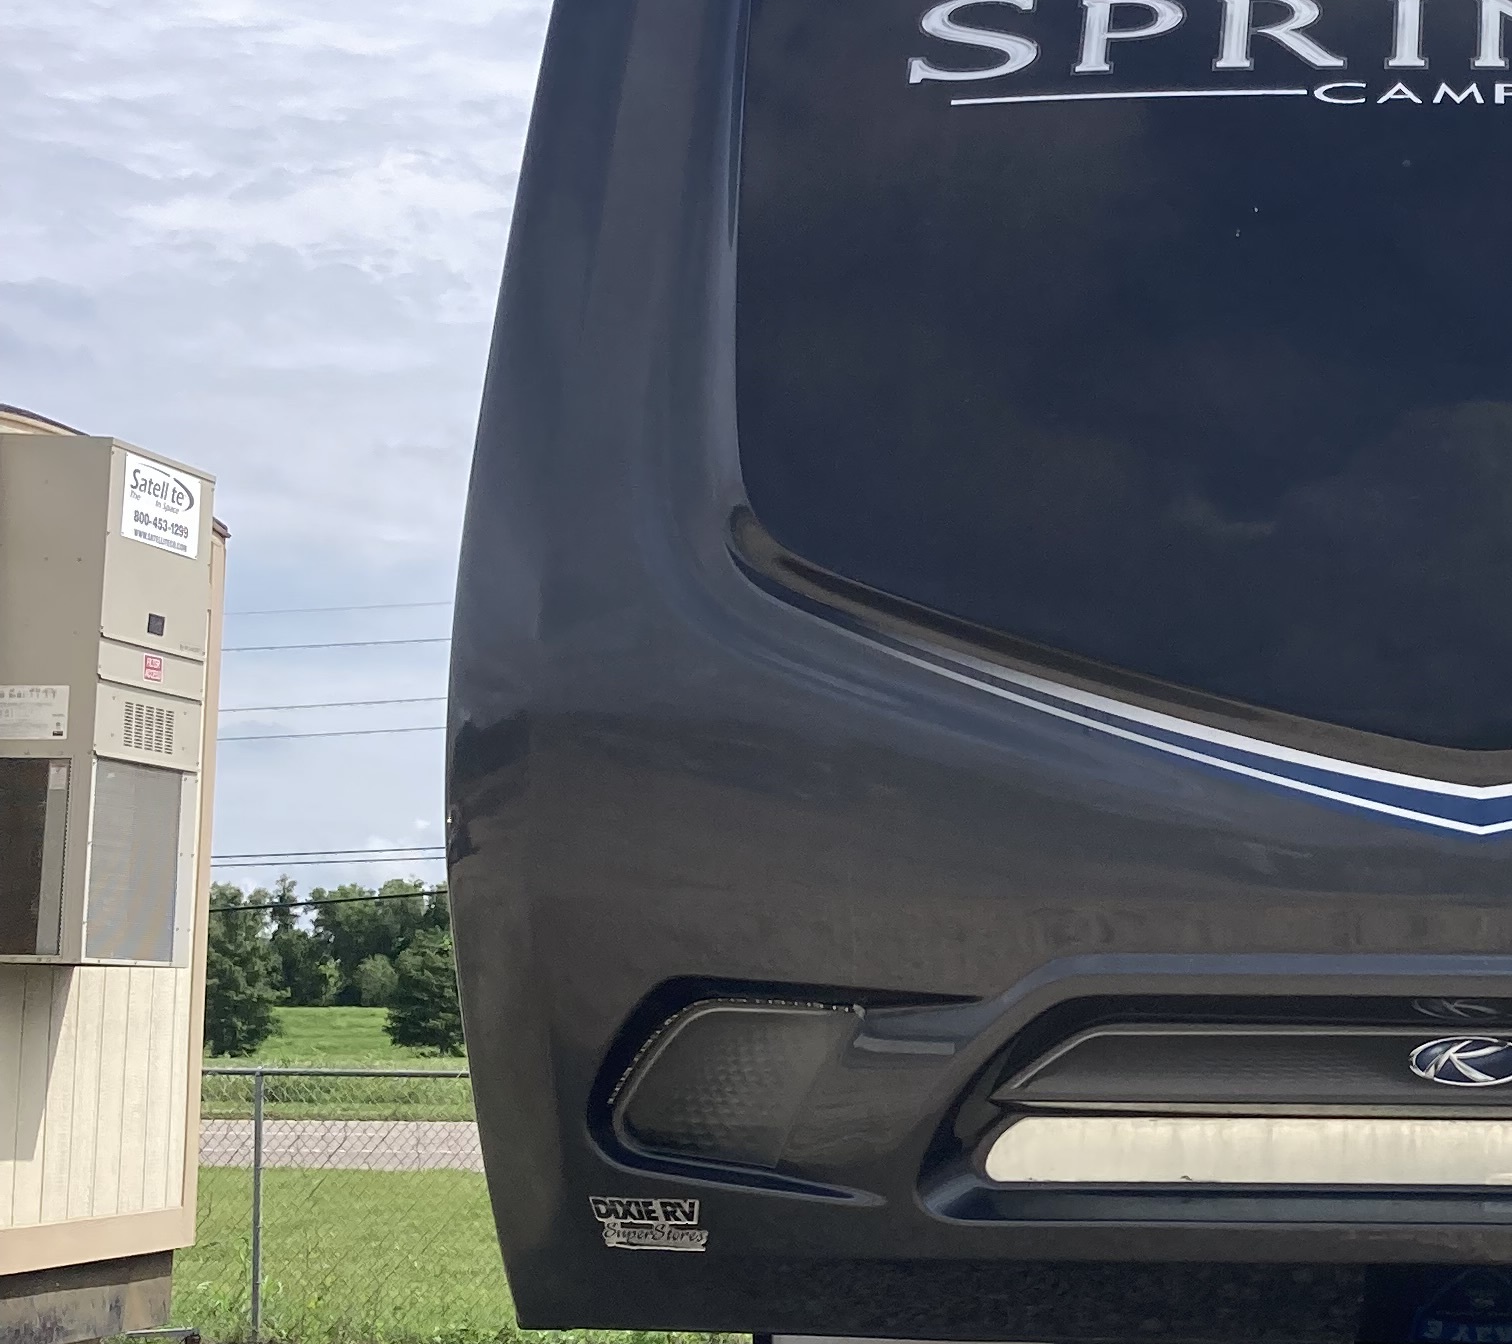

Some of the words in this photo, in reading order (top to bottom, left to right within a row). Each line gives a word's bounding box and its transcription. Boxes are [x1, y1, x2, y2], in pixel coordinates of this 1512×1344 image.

[130, 468, 185, 507] Satellte
[133, 510, 189, 539] 800-453-1299
[591, 1198, 660, 1222] DIXIE
[660, 1200, 696, 1222] RV
[604, 1222, 705, 1243] SuperStores
